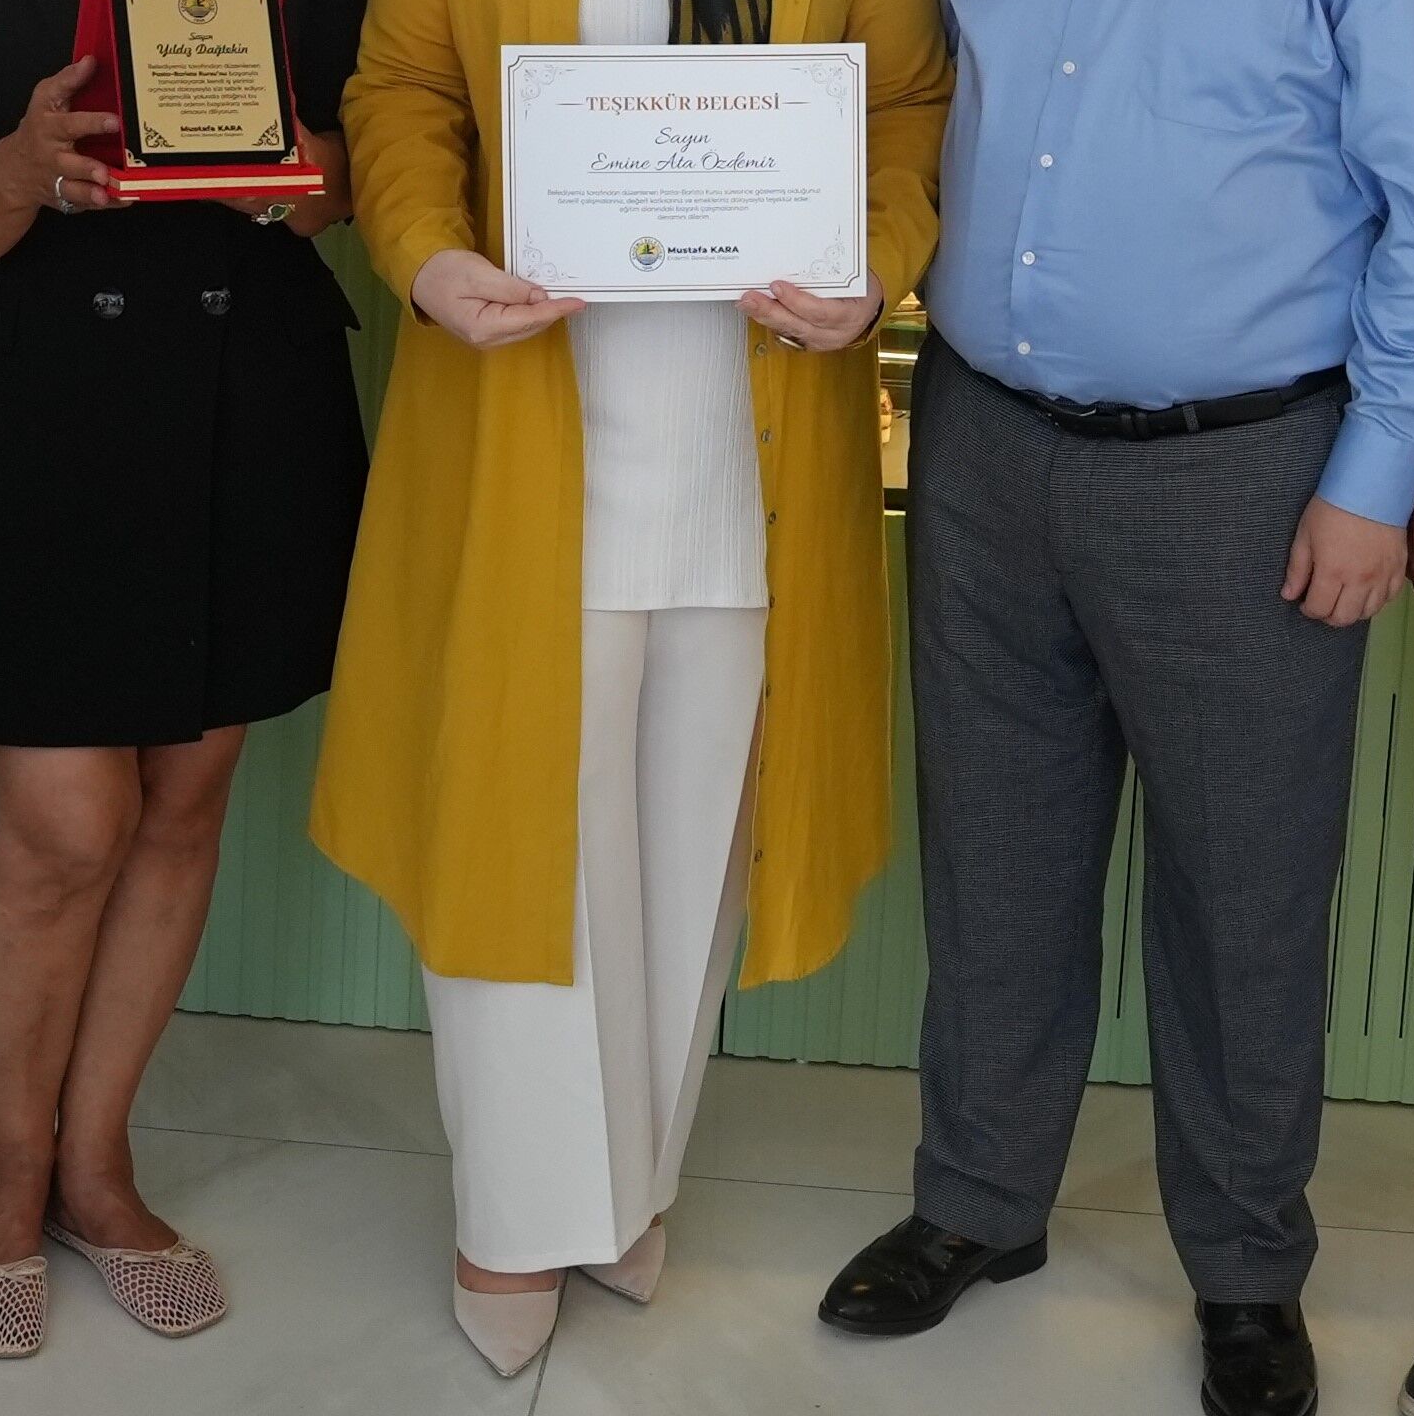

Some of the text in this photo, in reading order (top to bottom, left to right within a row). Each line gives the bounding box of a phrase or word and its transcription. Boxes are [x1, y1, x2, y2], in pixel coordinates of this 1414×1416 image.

[156, 43, 249, 58] Yıldız Dağtekin
[586, 92, 780, 116] TEŞEKKÜR BELGESİ
[655, 126, 711, 153] Sayın
[590, 149, 777, 171] Emine Ata Özdemir
[667, 245, 739, 254] Mustafa KARA
